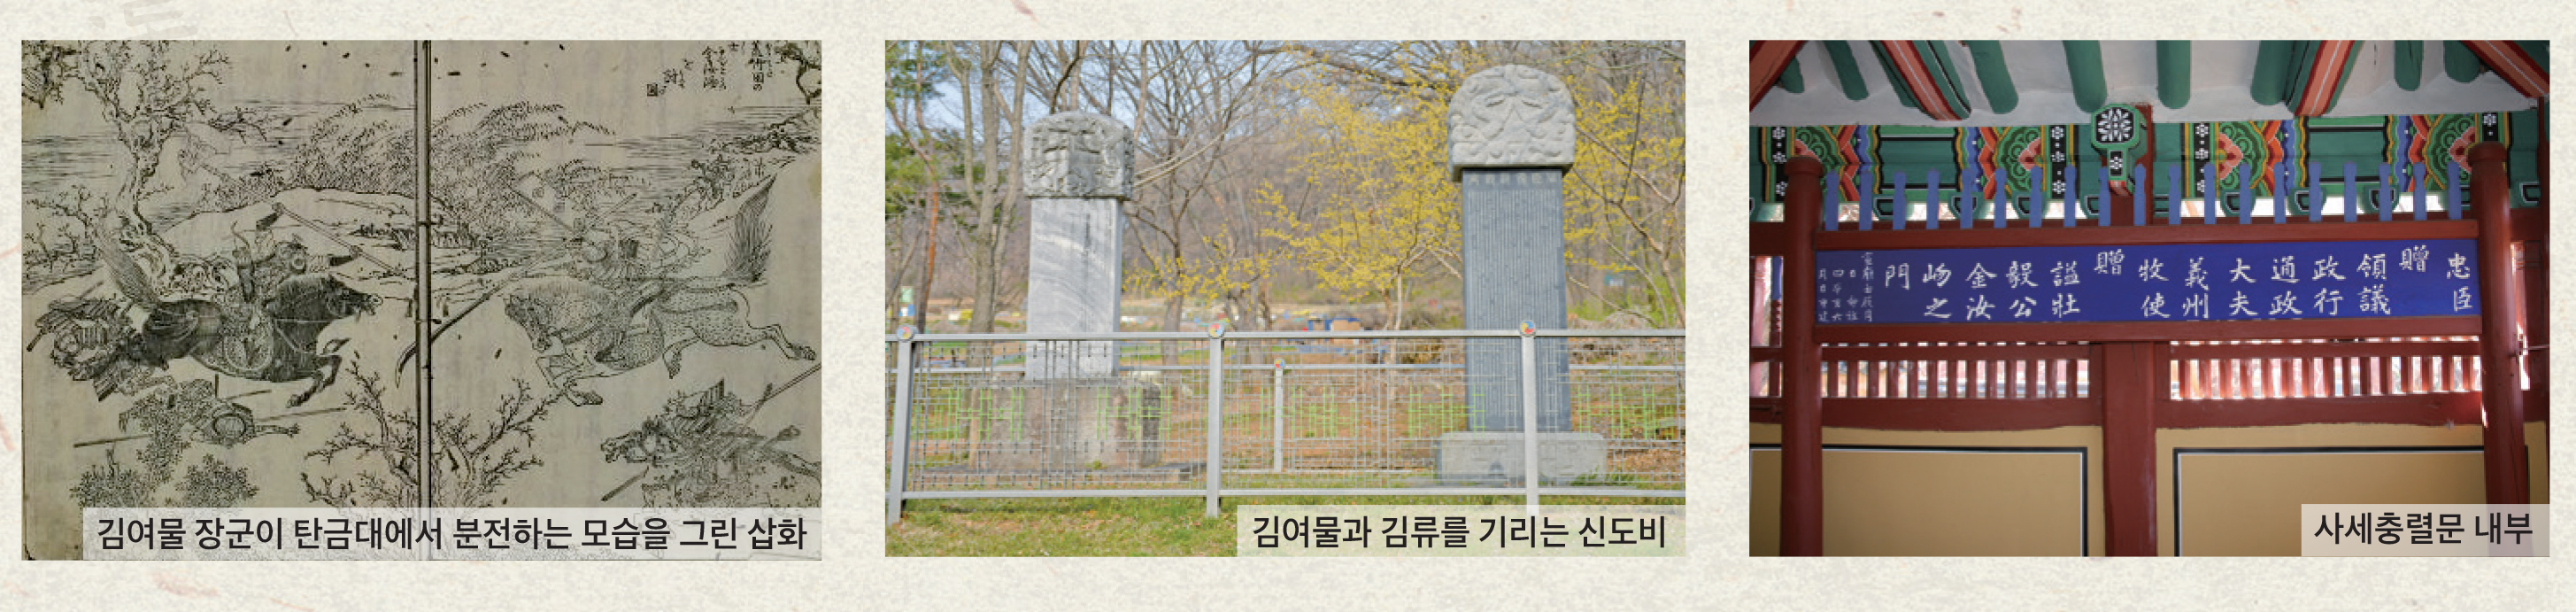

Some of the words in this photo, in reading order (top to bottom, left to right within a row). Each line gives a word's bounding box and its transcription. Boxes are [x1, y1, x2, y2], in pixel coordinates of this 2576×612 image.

[1885, 262, 1910, 291] 門
[1965, 262, 1998, 321] 金汝
[2005, 260, 2039, 319] 毅公
[2138, 257, 2171, 319] 牧使
[2181, 256, 2210, 320] 義州
[2227, 256, 2258, 317] 大夫
[2268, 254, 2303, 316] 通政
[2311, 253, 2347, 316] 政行
[2355, 252, 2391, 315] 領議
[2446, 252, 2473, 313] 忠臣
